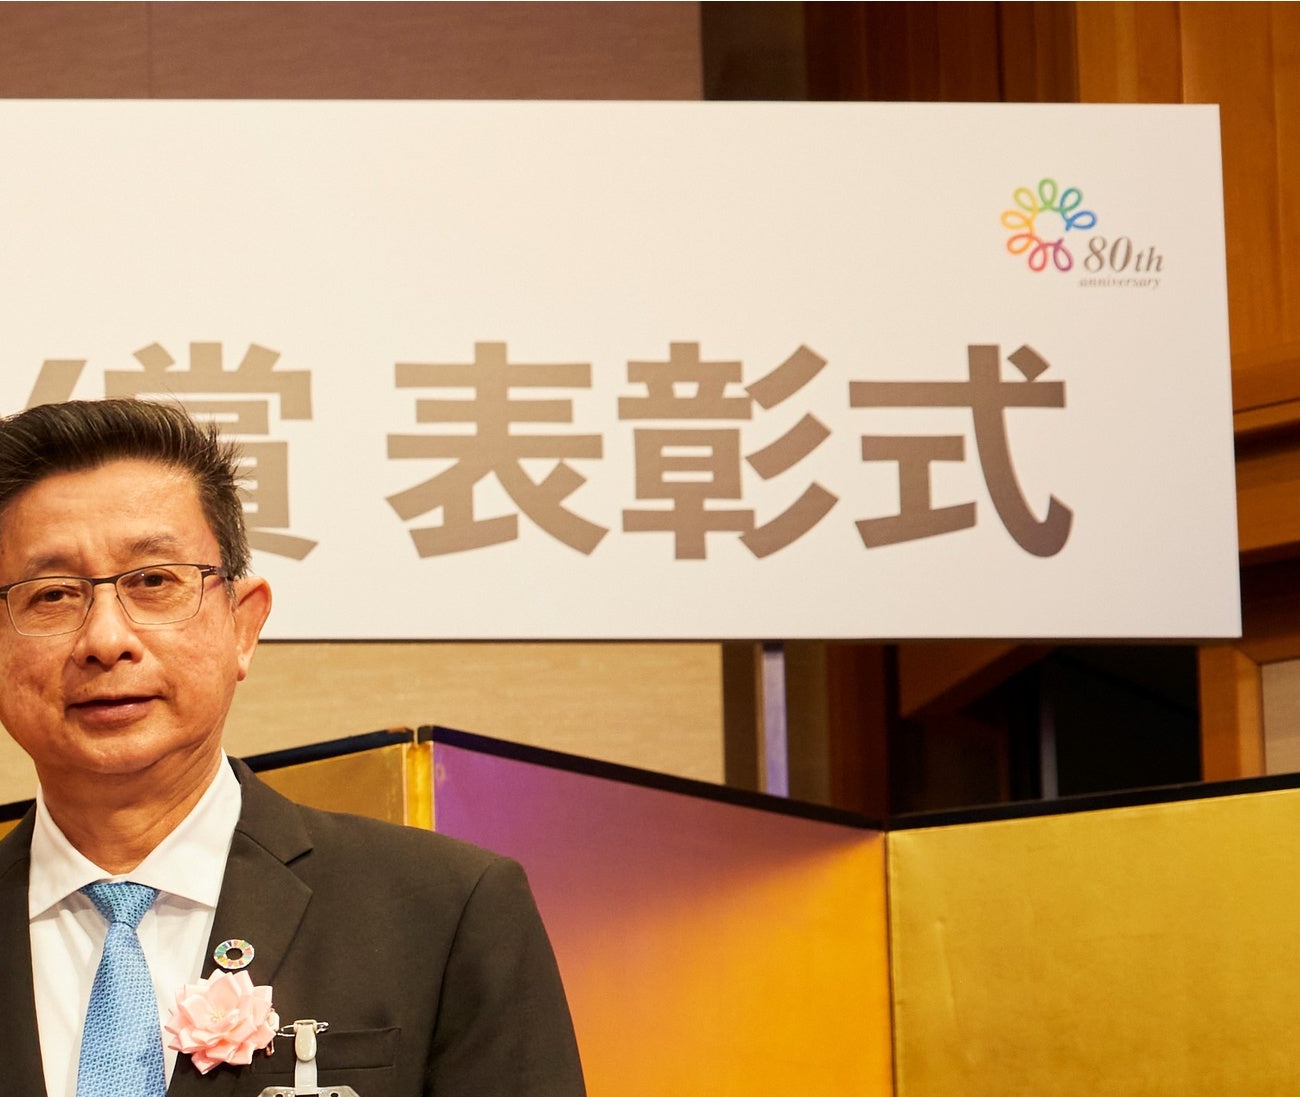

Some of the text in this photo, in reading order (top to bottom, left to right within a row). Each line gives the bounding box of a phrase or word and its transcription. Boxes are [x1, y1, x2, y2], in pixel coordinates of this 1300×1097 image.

[1083, 236, 1164, 272] 80th
[1078, 274, 1161, 289] anniversary
[385, 341, 1074, 560] 表彰式
